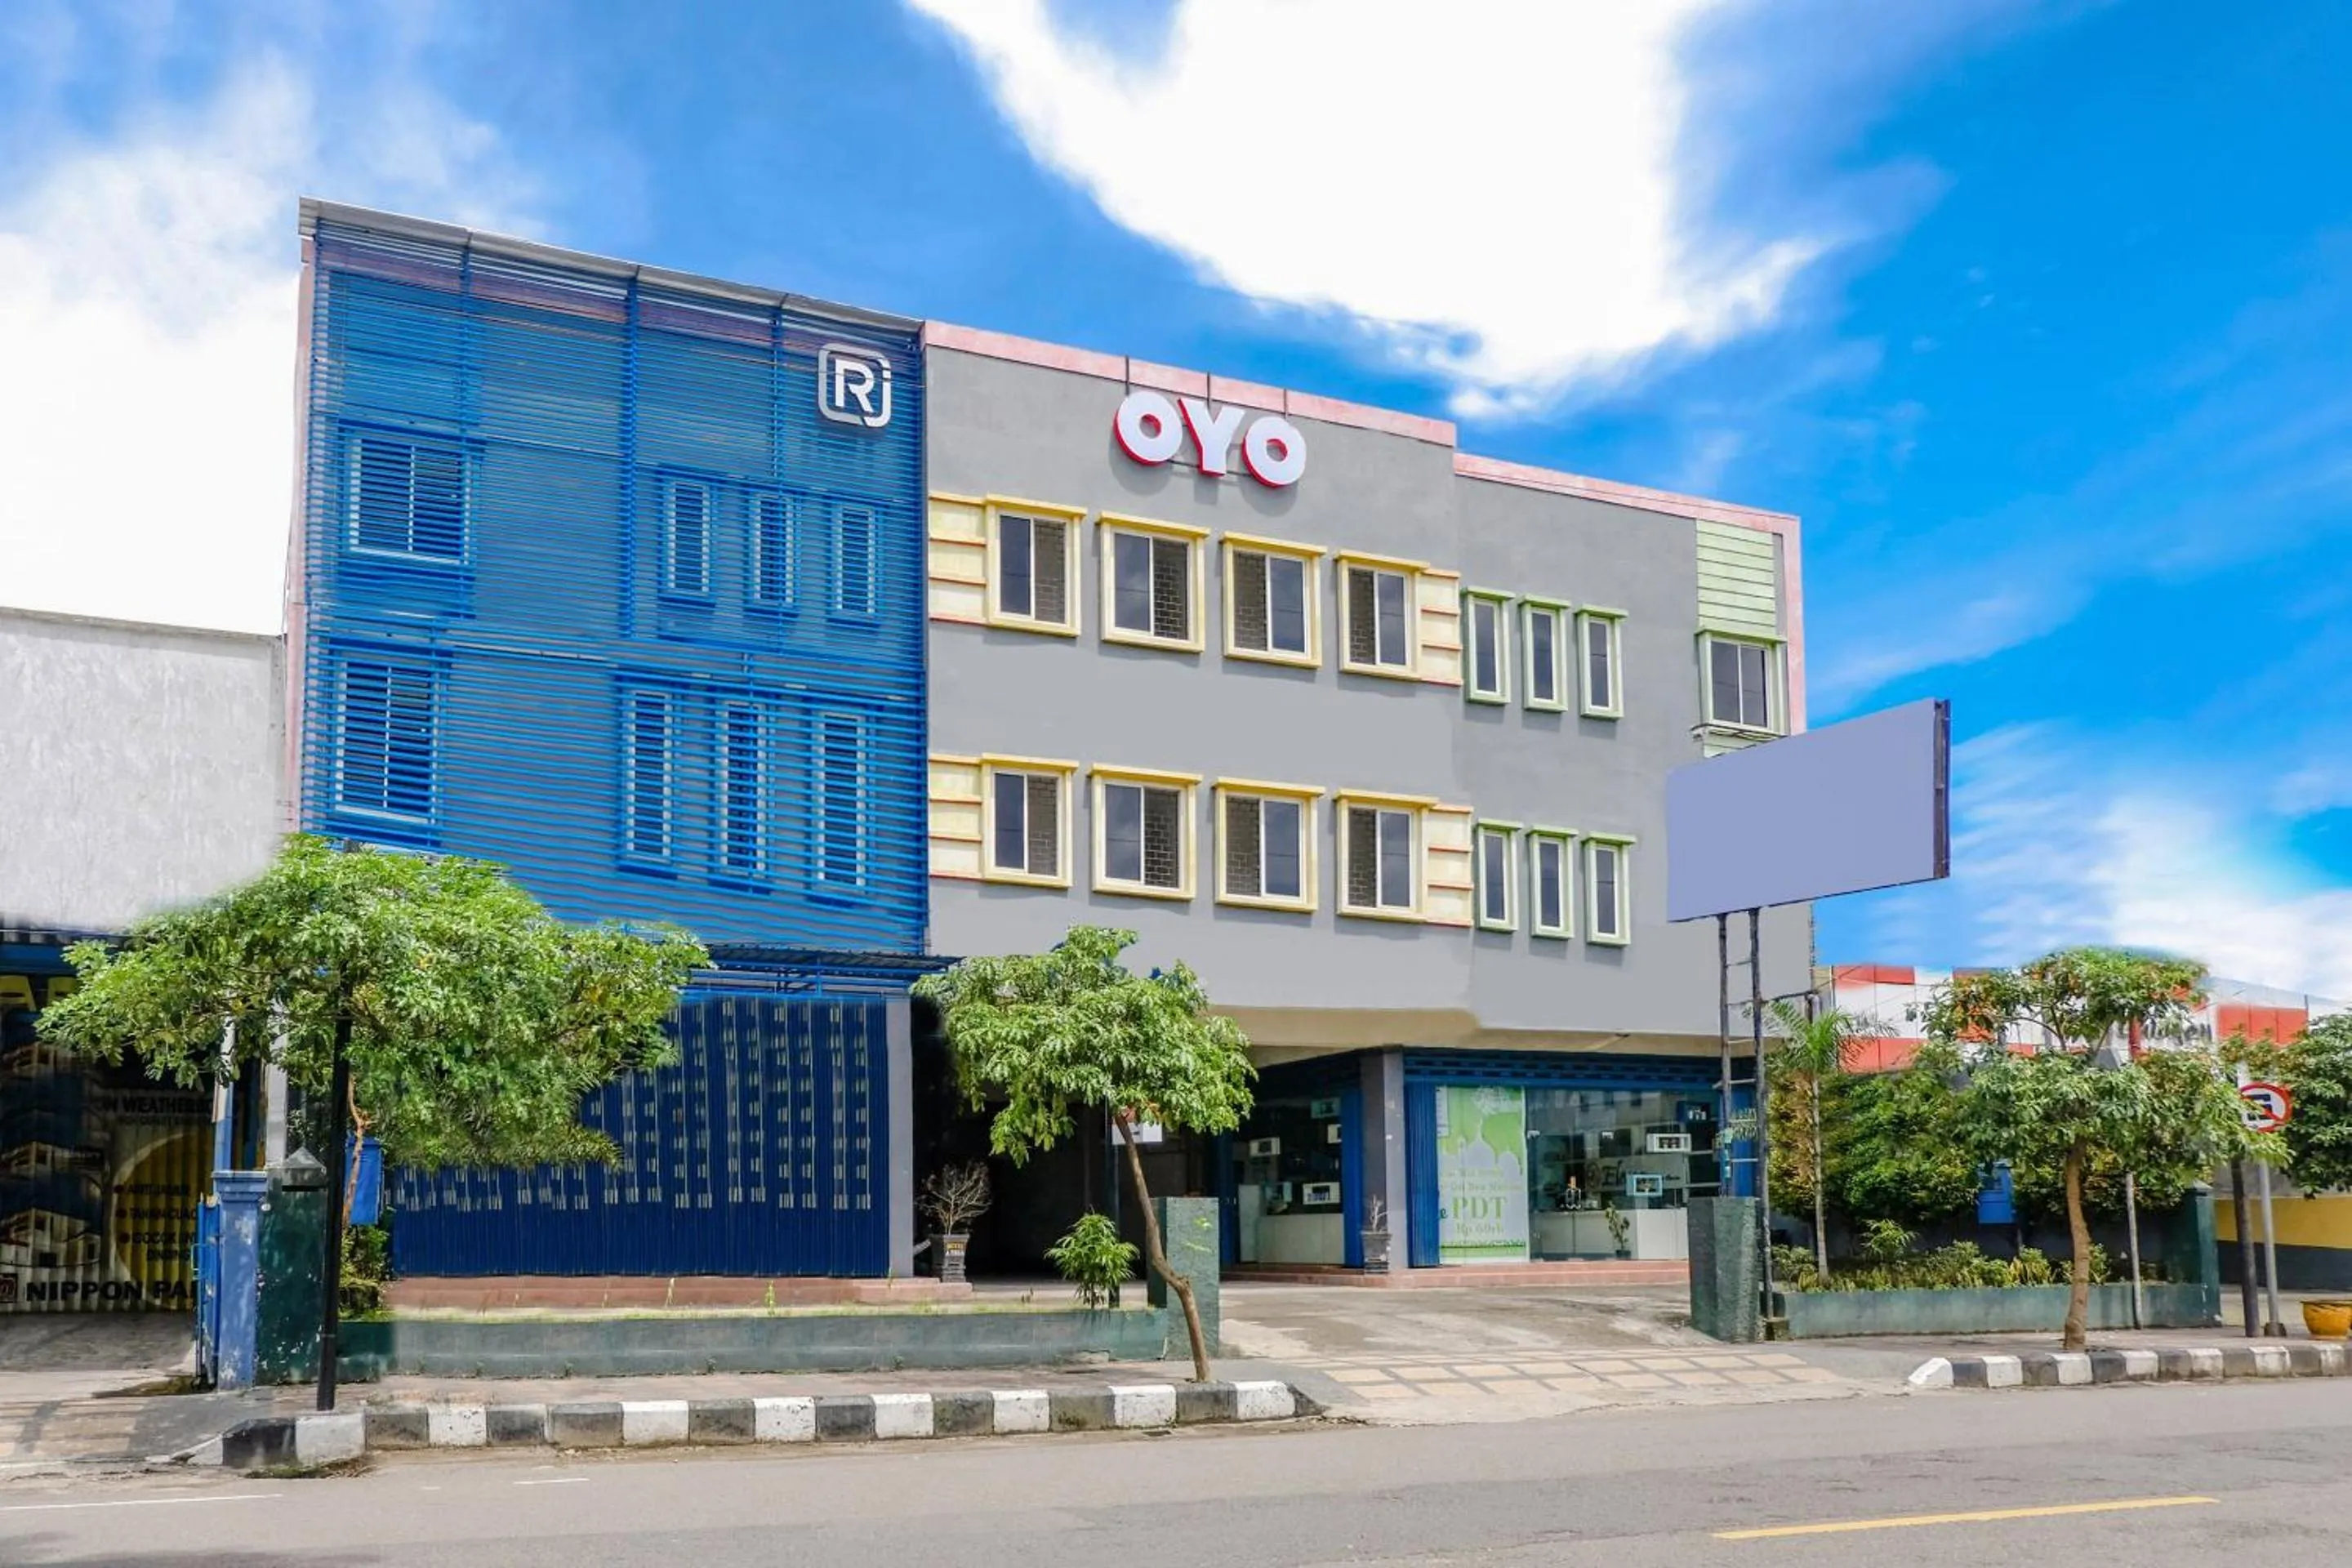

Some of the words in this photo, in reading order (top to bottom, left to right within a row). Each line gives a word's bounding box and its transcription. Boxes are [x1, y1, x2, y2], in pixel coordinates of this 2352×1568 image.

[1112, 391, 1307, 488] OYO
[1453, 1196, 1507, 1219] PDT
[26, 1281, 144, 1301] NIPPON
